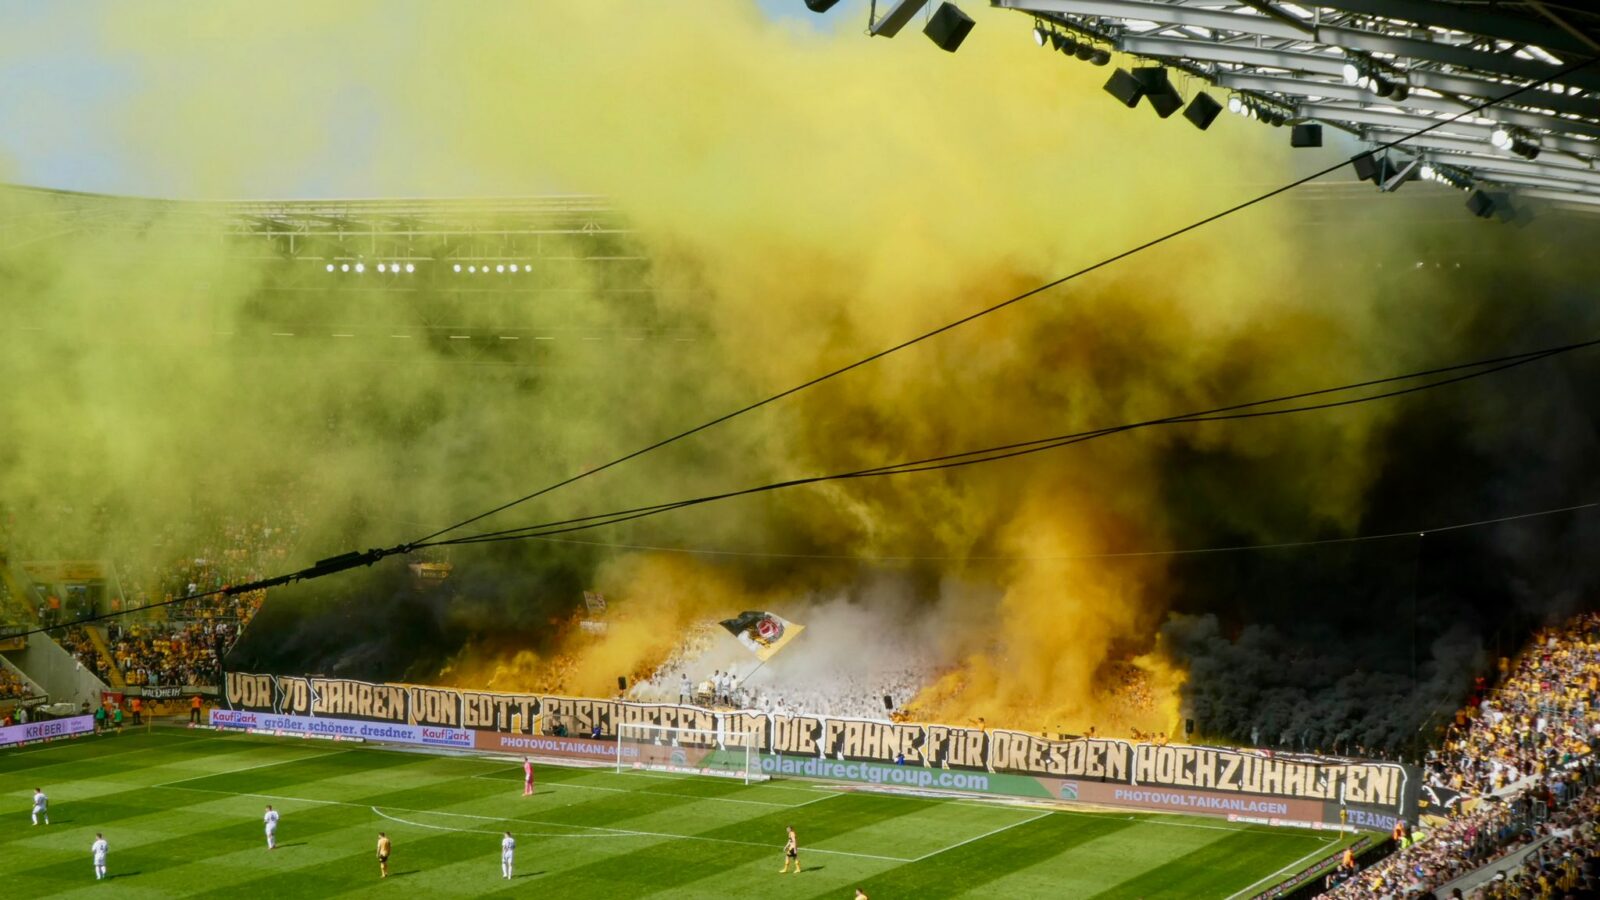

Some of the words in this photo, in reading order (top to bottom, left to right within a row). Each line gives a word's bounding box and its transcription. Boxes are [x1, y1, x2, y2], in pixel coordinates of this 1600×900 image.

[213, 712, 257, 723] KaufPark
[264, 719, 306, 731] größer.
[308, 723, 358, 735] schöner.
[361, 728, 416, 741] dresdner.
[422, 728, 470, 741] KaufPark
[227, 673, 271, 708] VOR
[278, 678, 307, 712] 70
[311, 680, 404, 721] JAHREN
[411, 688, 457, 726] VON
[464, 692, 537, 735] GOTT
[543, 698, 713, 744] ERSCHAFFEN
[724, 712, 767, 750] UM
[774, 715, 818, 753] DIE
[825, 719, 921, 763] FAHNE
[928, 727, 988, 770] FÜR
[993, 731, 1127, 781] DRESDEN
[1136, 745, 1400, 807] HOCHZUHALTEN!
[501, 737, 639, 758] PHOTOVOLTAIKANLAGEN
[750, 757, 988, 791] solardirectgroup.com
[1115, 789, 1287, 814] PHOTOVOLTAIKANLAGEN
